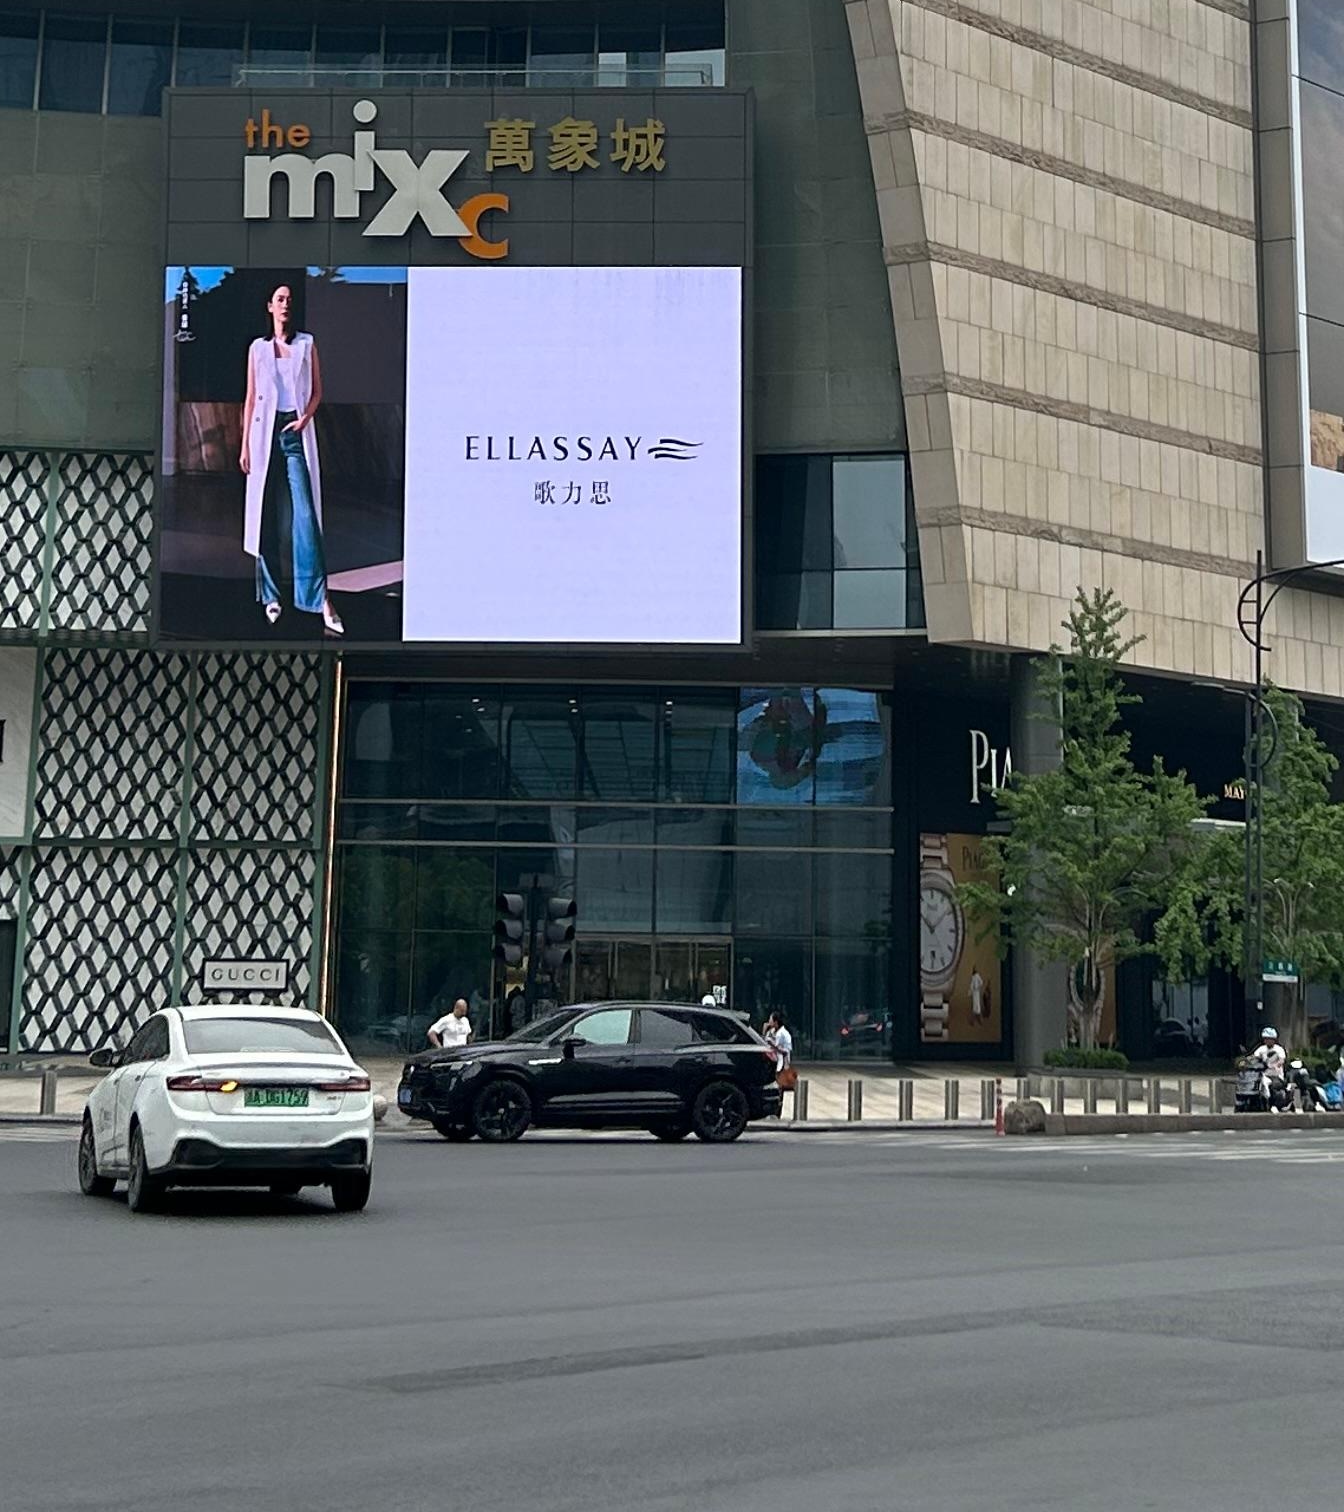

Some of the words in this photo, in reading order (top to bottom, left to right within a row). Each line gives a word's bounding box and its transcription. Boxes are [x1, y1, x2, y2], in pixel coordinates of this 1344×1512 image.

[244, 109, 311, 148] the
[484, 117, 666, 174] 萬象城
[465, 435, 643, 462] ELLASSAY
[534, 480, 612, 506] 歌力思
[211, 968, 279, 982] GUCCI
